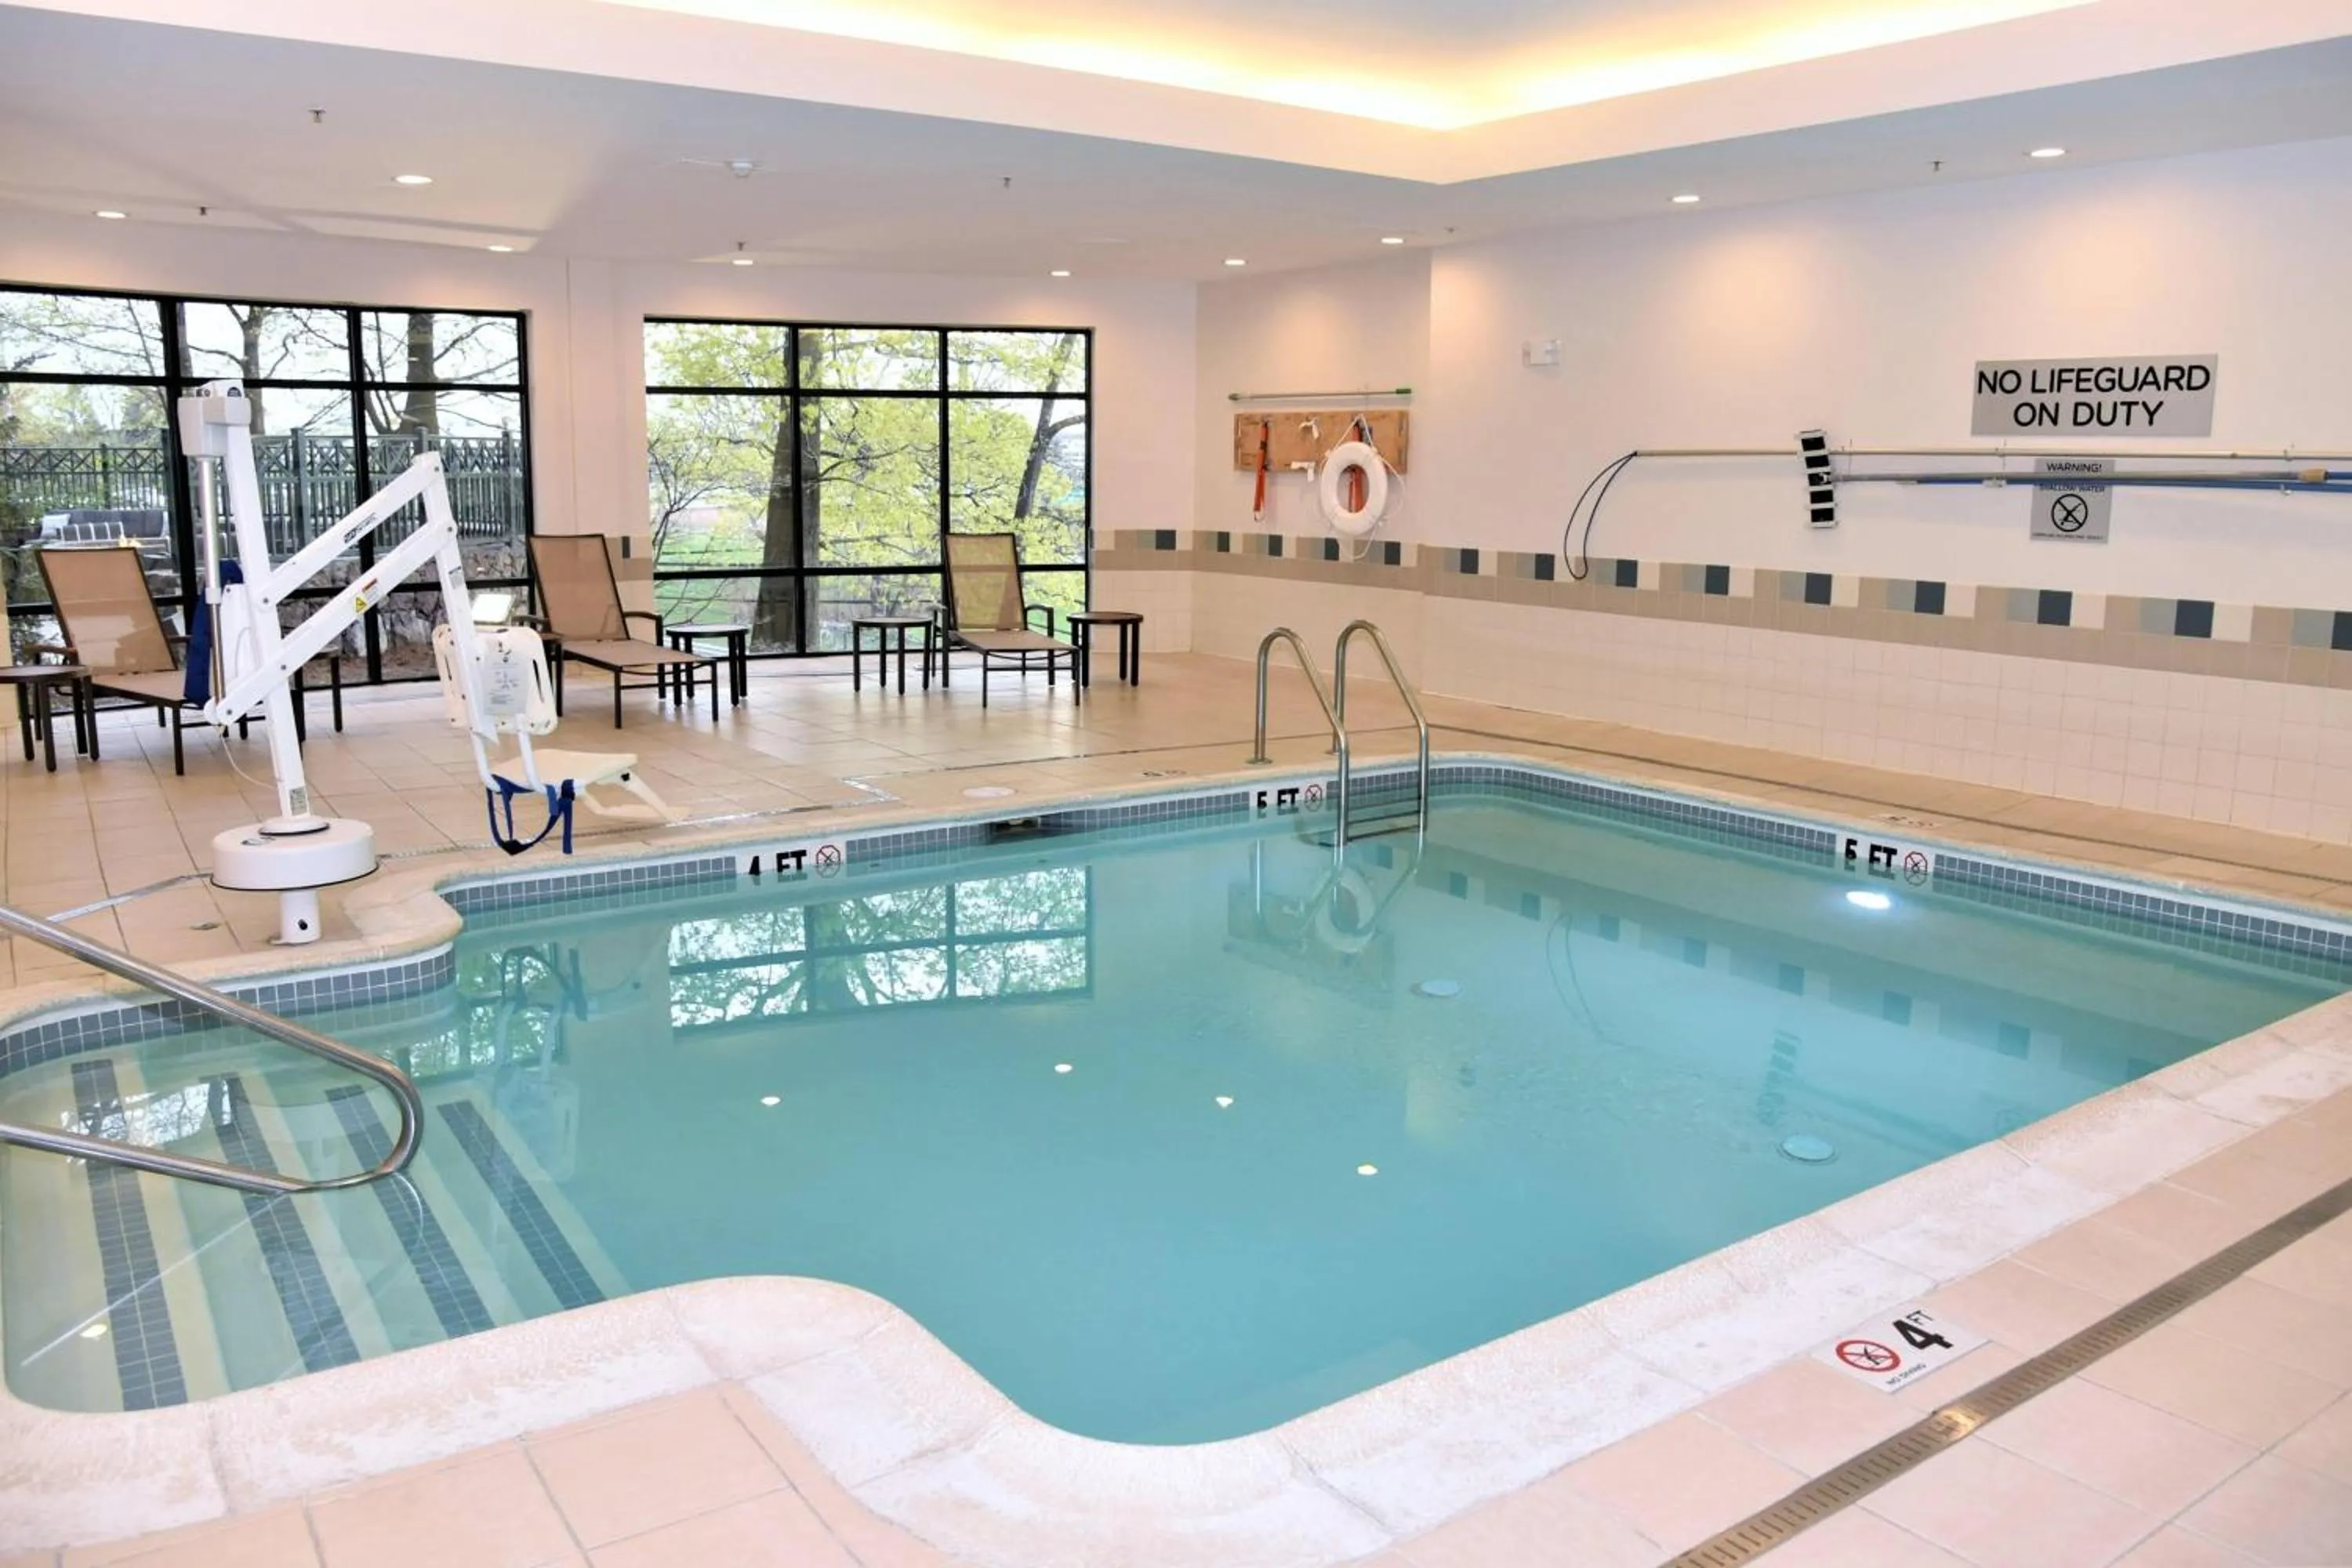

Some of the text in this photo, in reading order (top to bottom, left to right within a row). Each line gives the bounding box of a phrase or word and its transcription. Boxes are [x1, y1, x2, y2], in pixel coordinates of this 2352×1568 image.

[1977, 365, 2210, 394] NO LIFEGUARD
[2013, 401, 2164, 427] ON DUTY
[2046, 463, 2103, 473] WARNING!
[1277, 787, 1299, 806] FT
[775, 849, 807, 873] FT
[1868, 843, 1897, 868] FT
[1905, 1310, 1934, 1326] FT
[1892, 1319, 1954, 1350] 4
